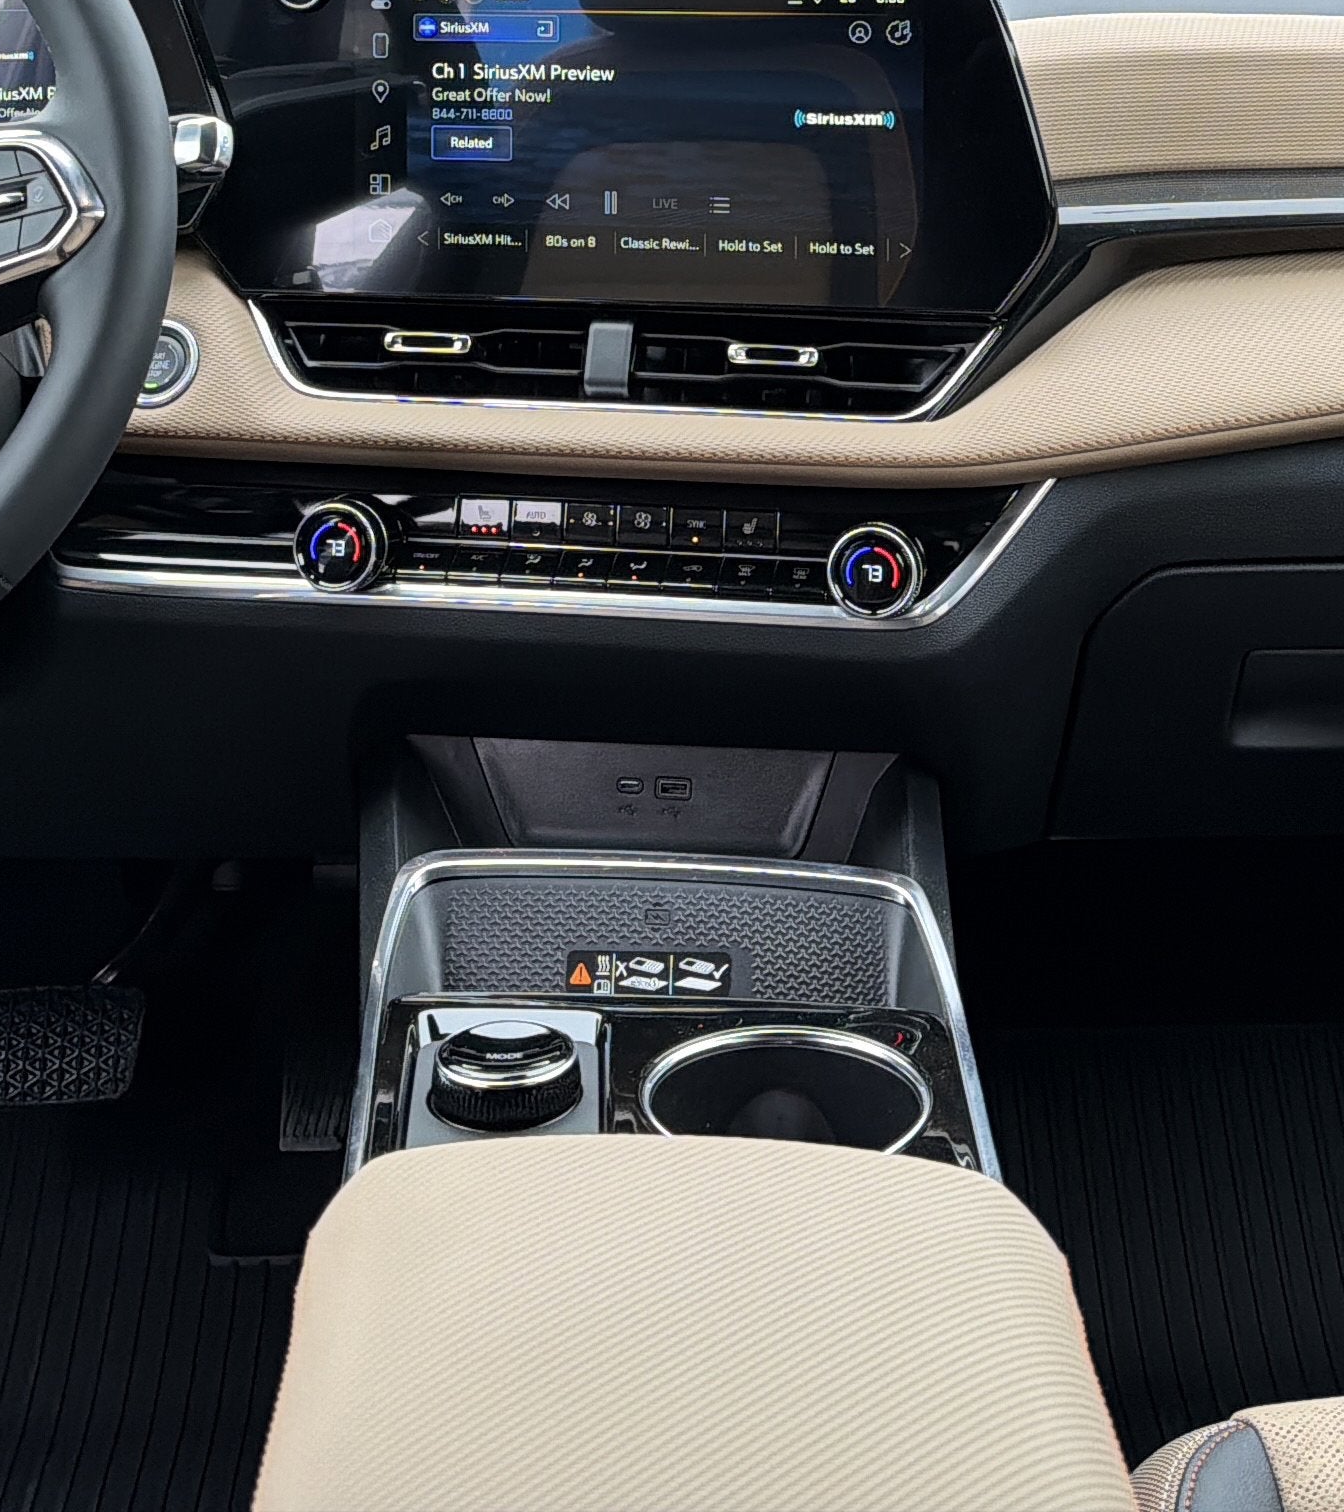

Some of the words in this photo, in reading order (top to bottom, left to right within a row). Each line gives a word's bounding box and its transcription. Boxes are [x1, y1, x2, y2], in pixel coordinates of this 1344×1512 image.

[440, 22, 490, 34] SiriusXM
[431, 62, 454, 80] Ch
[459, 63, 465, 79] 1
[473, 63, 545, 80] SiriusXM
[550, 64, 615, 82] Preview
[431, 88, 471, 102] Great
[473, 87, 512, 102] Offer
[515, 88, 552, 103] Now!
[432, 108, 514, 121] 844-711-8800
[450, 136, 493, 149] Related
[451, 194, 463, 204] CH
[652, 198, 678, 210] LIVE
[443, 233, 492, 246] SiriusXM
[545, 235, 568, 248] 80s
[570, 238, 585, 248] on
[587, 236, 596, 248] 8
[620, 237, 660, 250] Classic
[718, 240, 747, 253] Hold
[748, 242, 761, 253] to
[763, 240, 783, 253] Set
[809, 242, 837, 255] Hold
[839, 243, 853, 255] to
[854, 243, 875, 256] Set
[526, 510, 546, 520] AUTO
[686, 519, 706, 529] SYNC
[326, 539, 345, 557] 73
[862, 564, 883, 582] 73
[486, 1051, 524, 1060] MODE
